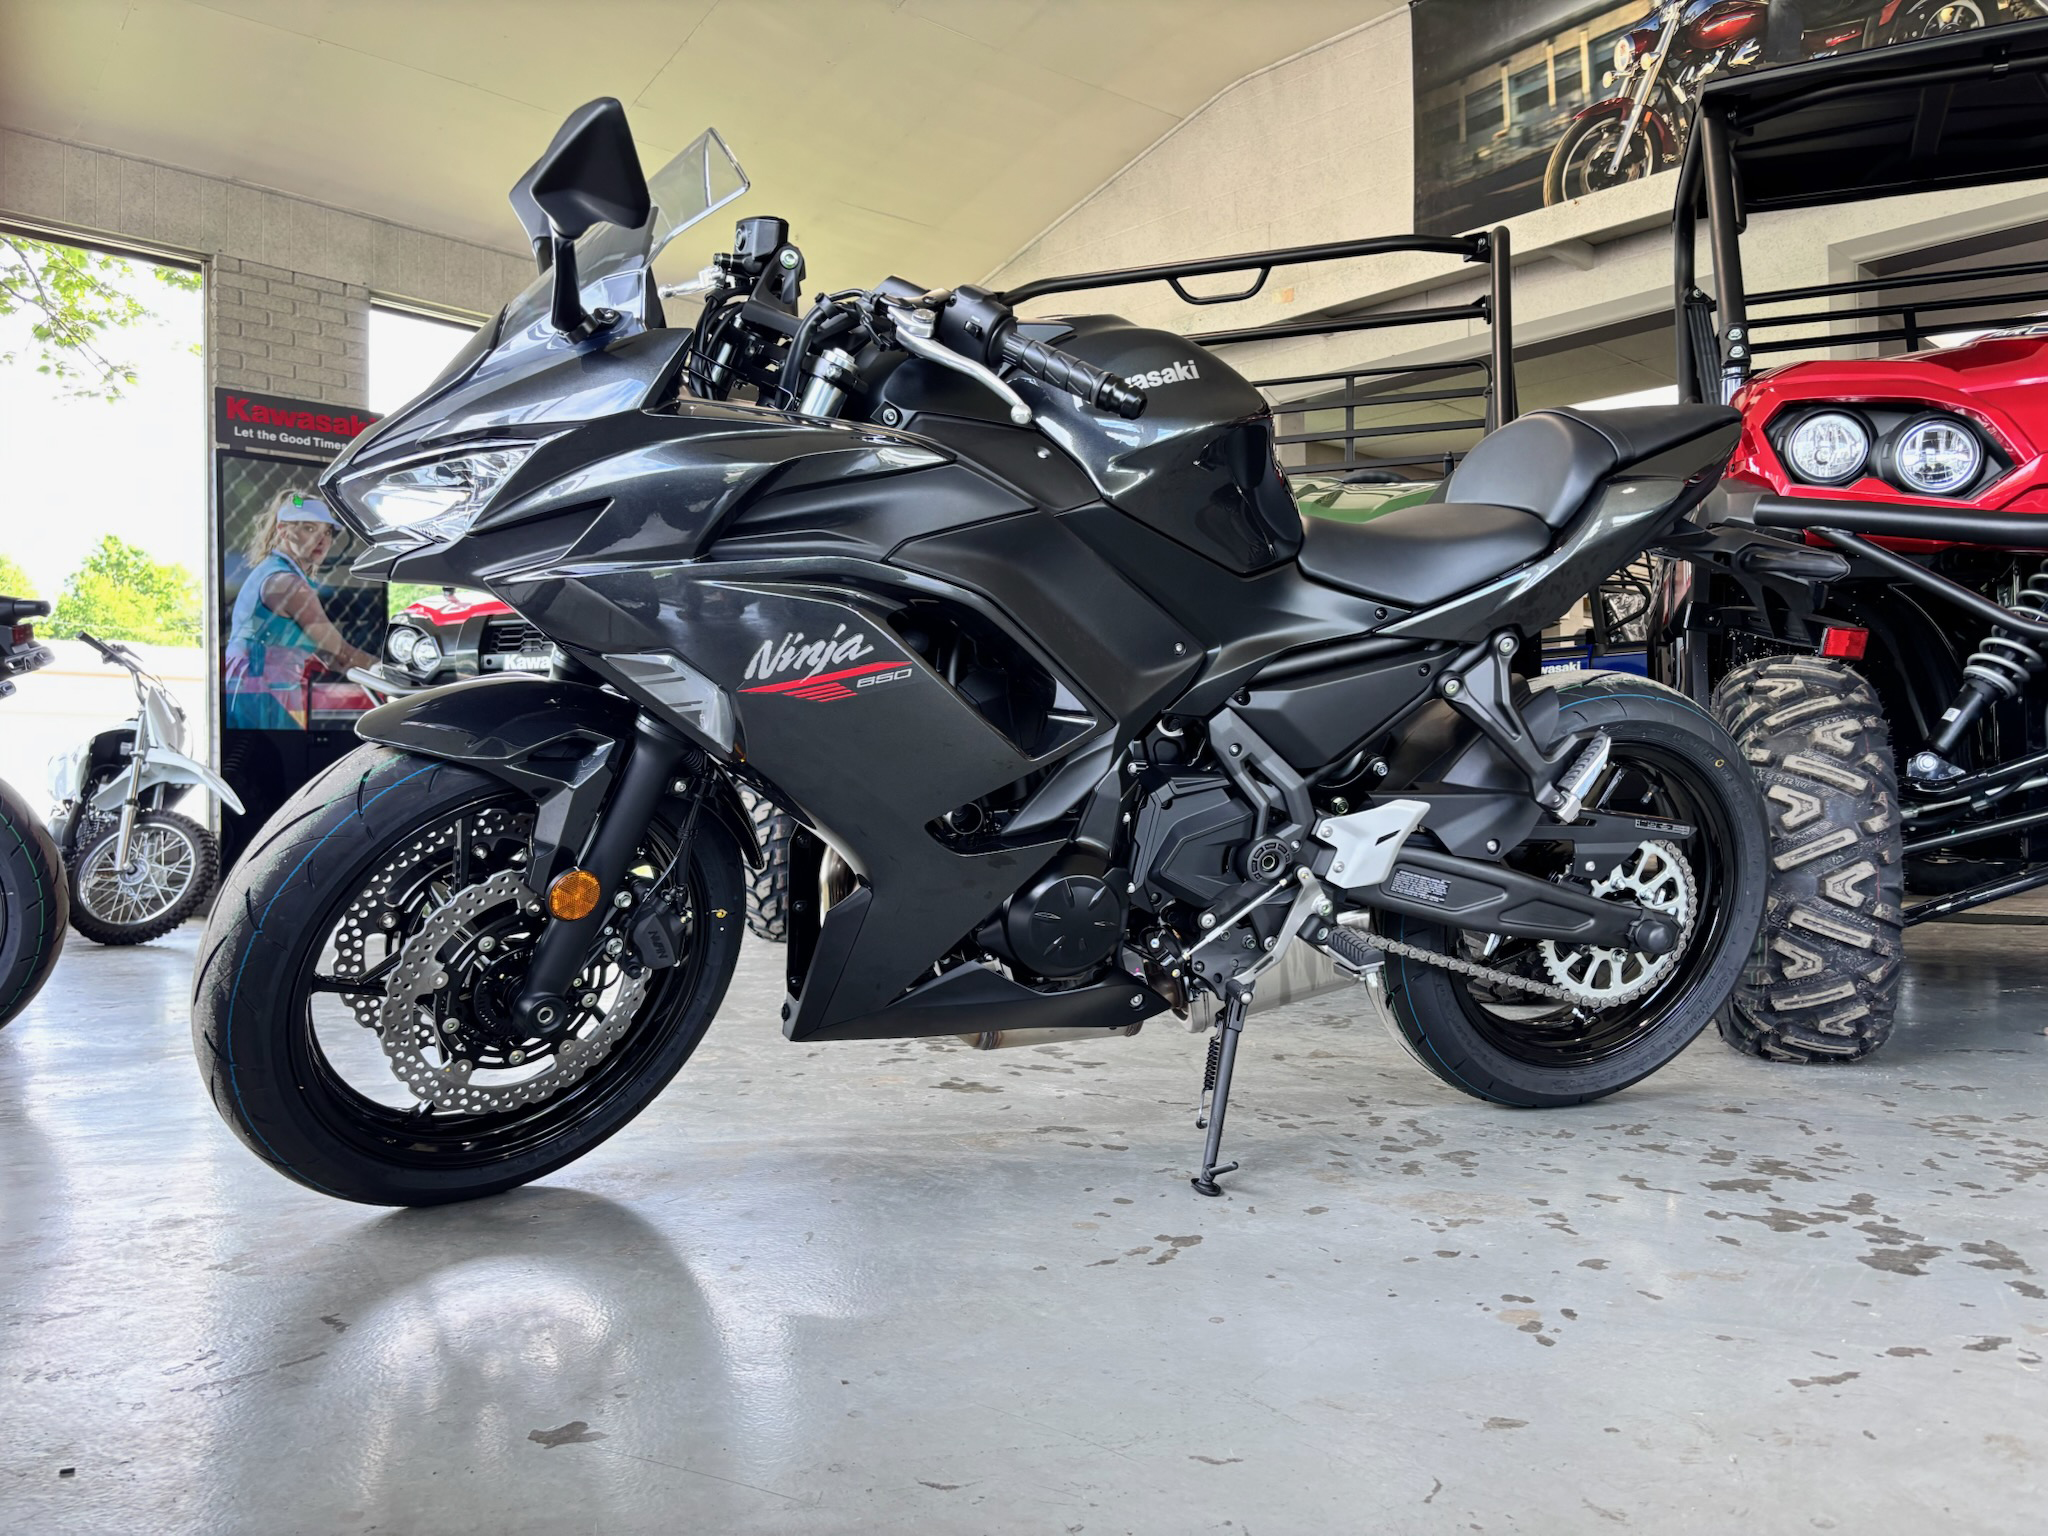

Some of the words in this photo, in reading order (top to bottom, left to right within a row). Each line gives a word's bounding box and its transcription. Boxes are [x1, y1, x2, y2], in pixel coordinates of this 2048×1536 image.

[1124, 360, 1200, 389] asaki
[234, 426, 254, 438] Let
[257, 430, 277, 442] the
[279, 433, 311, 446] Good
[744, 623, 875, 684] Ninja
